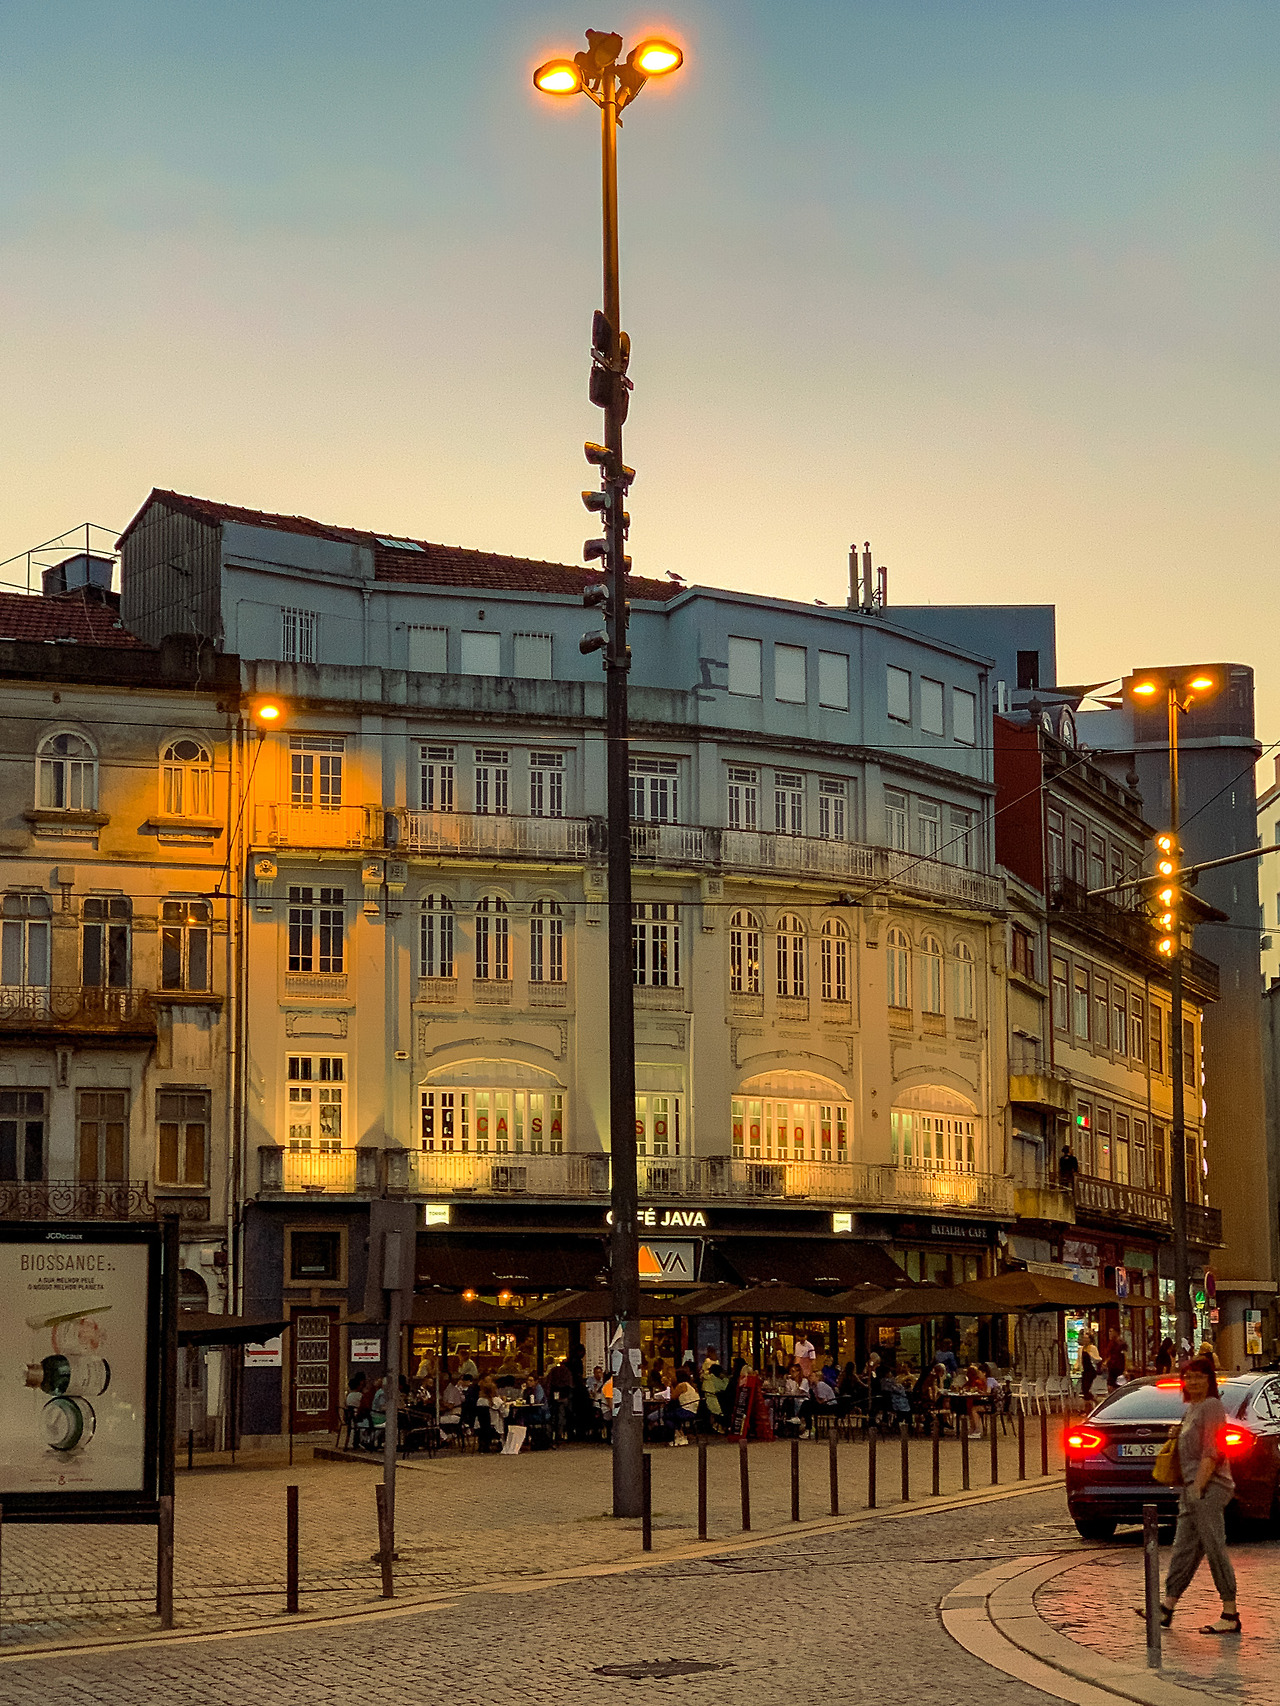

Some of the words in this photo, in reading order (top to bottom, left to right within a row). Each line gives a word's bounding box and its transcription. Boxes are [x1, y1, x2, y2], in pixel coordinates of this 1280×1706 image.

[476, 1116, 562, 1133] CASA
[660, 1211, 706, 1227] JAVA
[45, 1232, 83, 1240] JCDecaux
[931, 1224, 965, 1237] BATALHA
